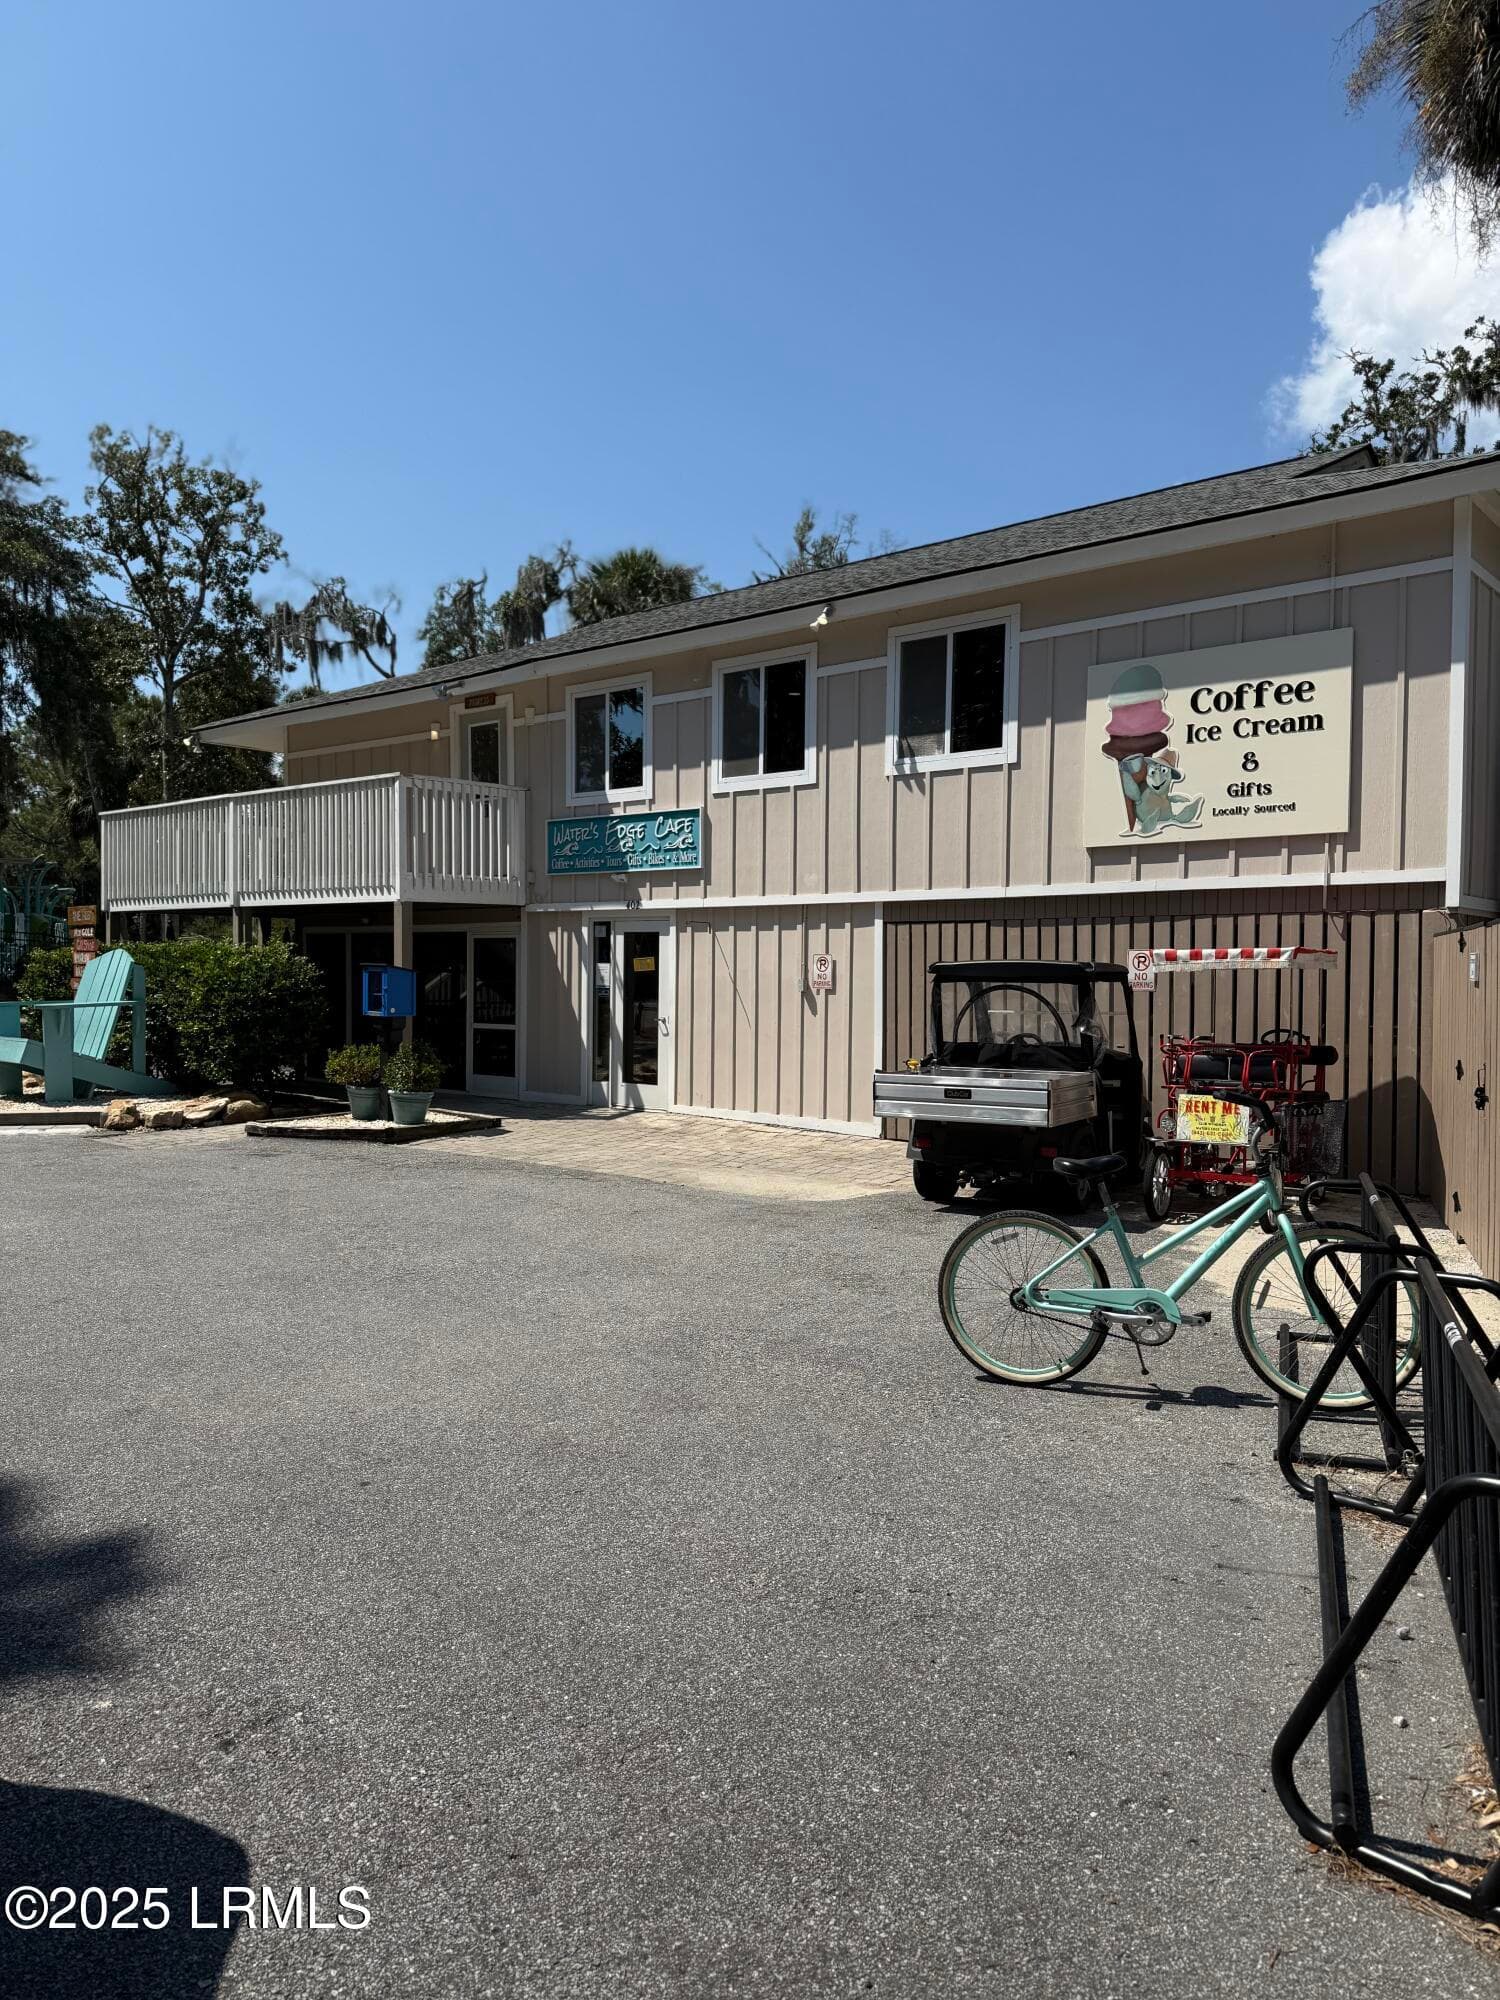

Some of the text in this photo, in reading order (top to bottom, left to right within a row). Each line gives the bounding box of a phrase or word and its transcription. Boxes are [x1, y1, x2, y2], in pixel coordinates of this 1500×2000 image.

[1190, 680, 1316, 715] Coffee
[1186, 713, 1325, 744] Ice Cream
[1241, 751, 1259, 772] &
[1227, 781, 1273, 798] Gifts
[1212, 802, 1296, 817] Locally Sourced
[553, 816, 695, 846] WATER'S EDGE CAFE
[627, 852, 642, 865] Gifts
[648, 851, 665, 864] Bikes
[1134, 972, 1148, 981] NO
[1185, 1100, 1241, 1116] RENT ME
